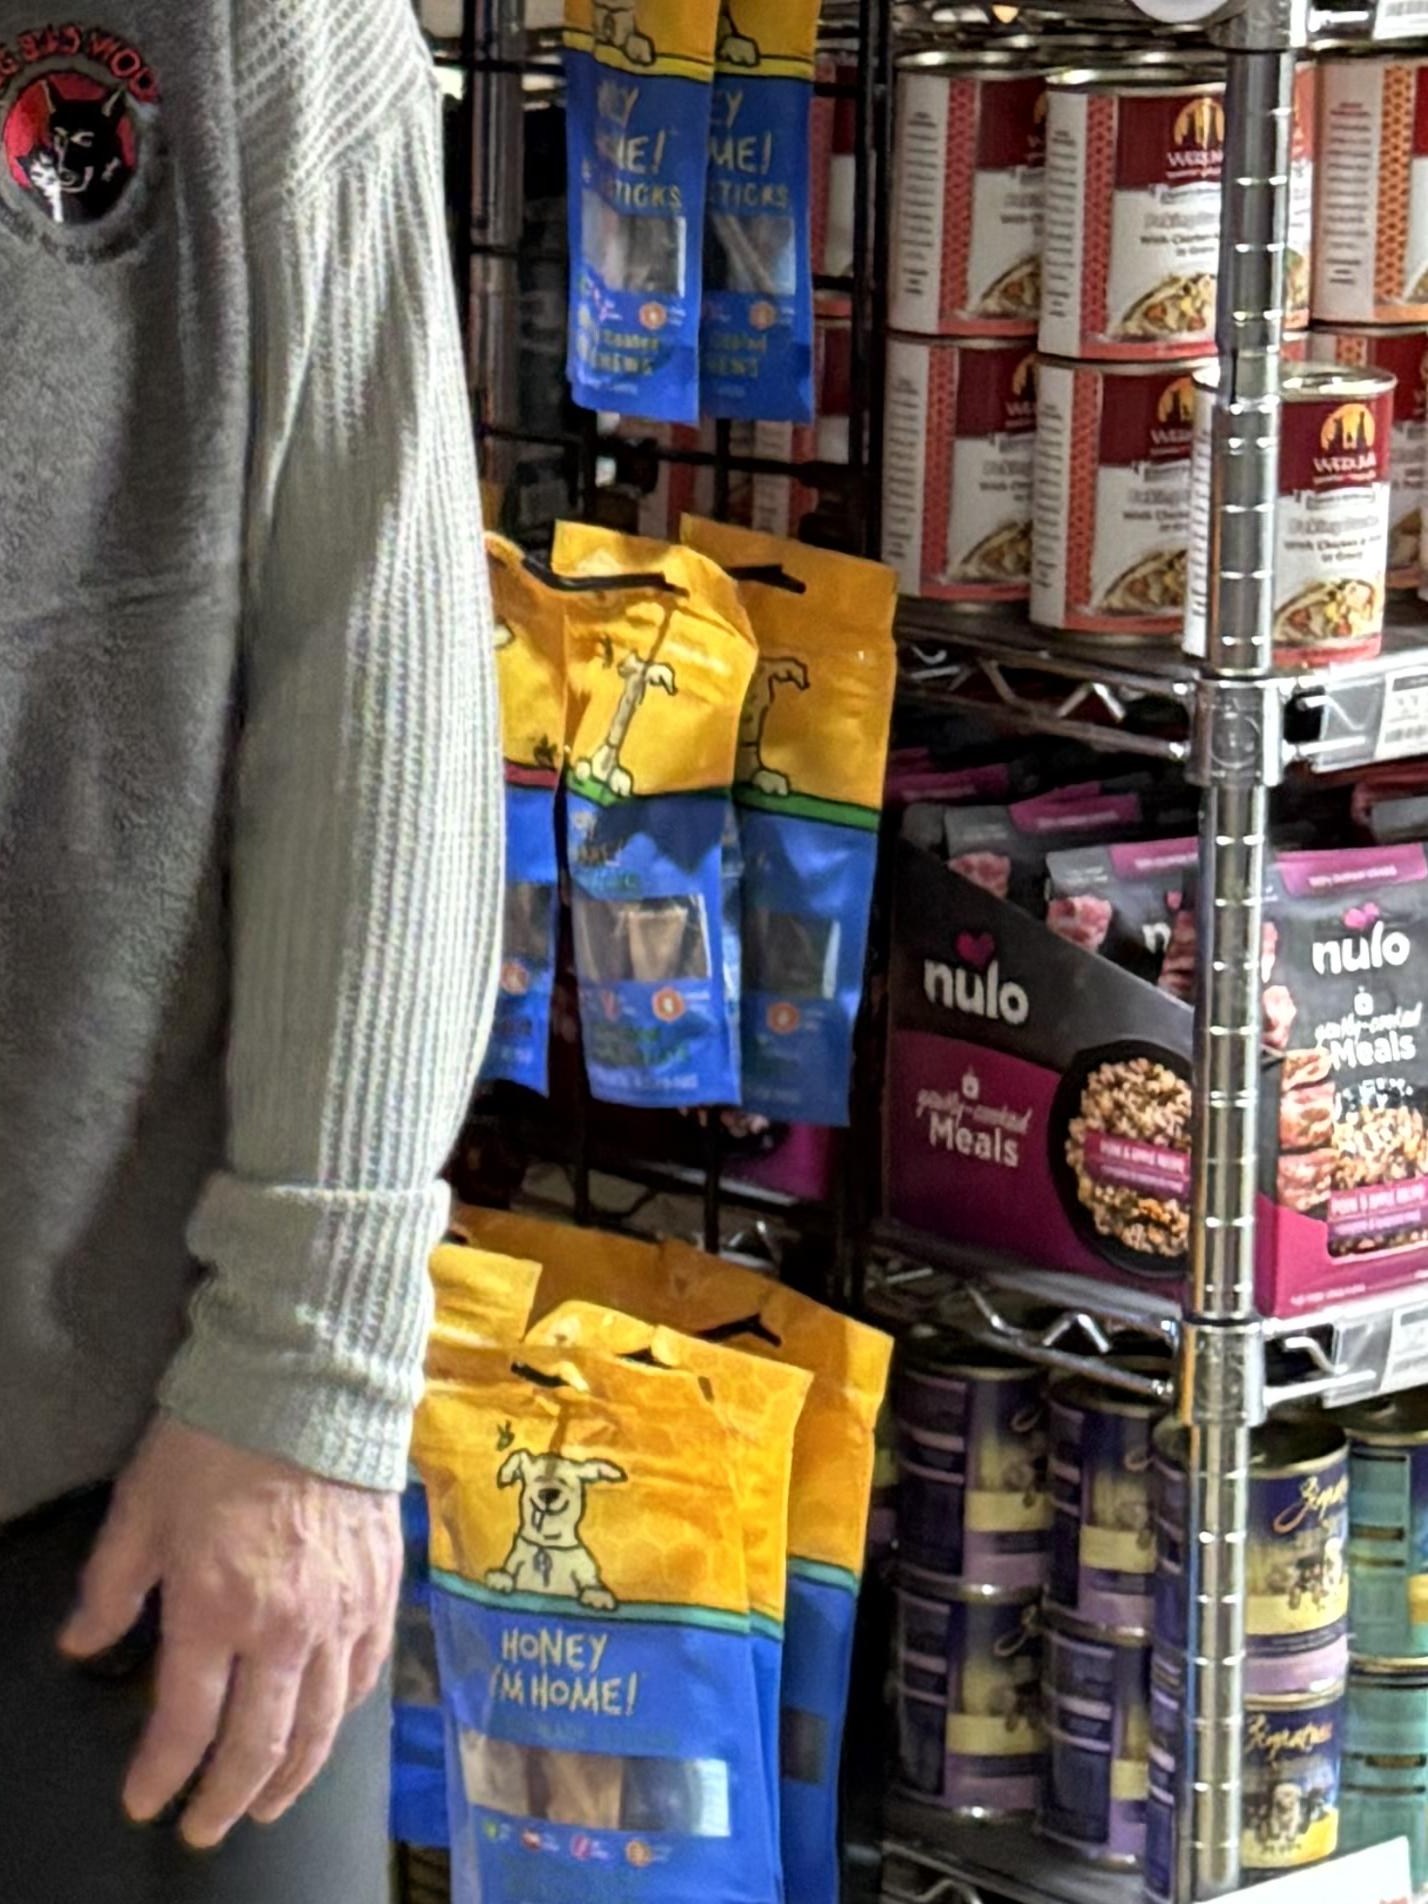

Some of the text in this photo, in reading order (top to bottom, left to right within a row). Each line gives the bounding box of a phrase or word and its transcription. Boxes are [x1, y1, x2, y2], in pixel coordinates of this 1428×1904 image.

[1312, 920, 1411, 975] nulo
[924, 958, 1029, 1025] nulo
[1329, 1030, 1417, 1071] Meals
[929, 1110, 1018, 1168] Meals
[502, 1627, 609, 1673] HONEY
[489, 1663, 638, 1718] I'M HOME!
